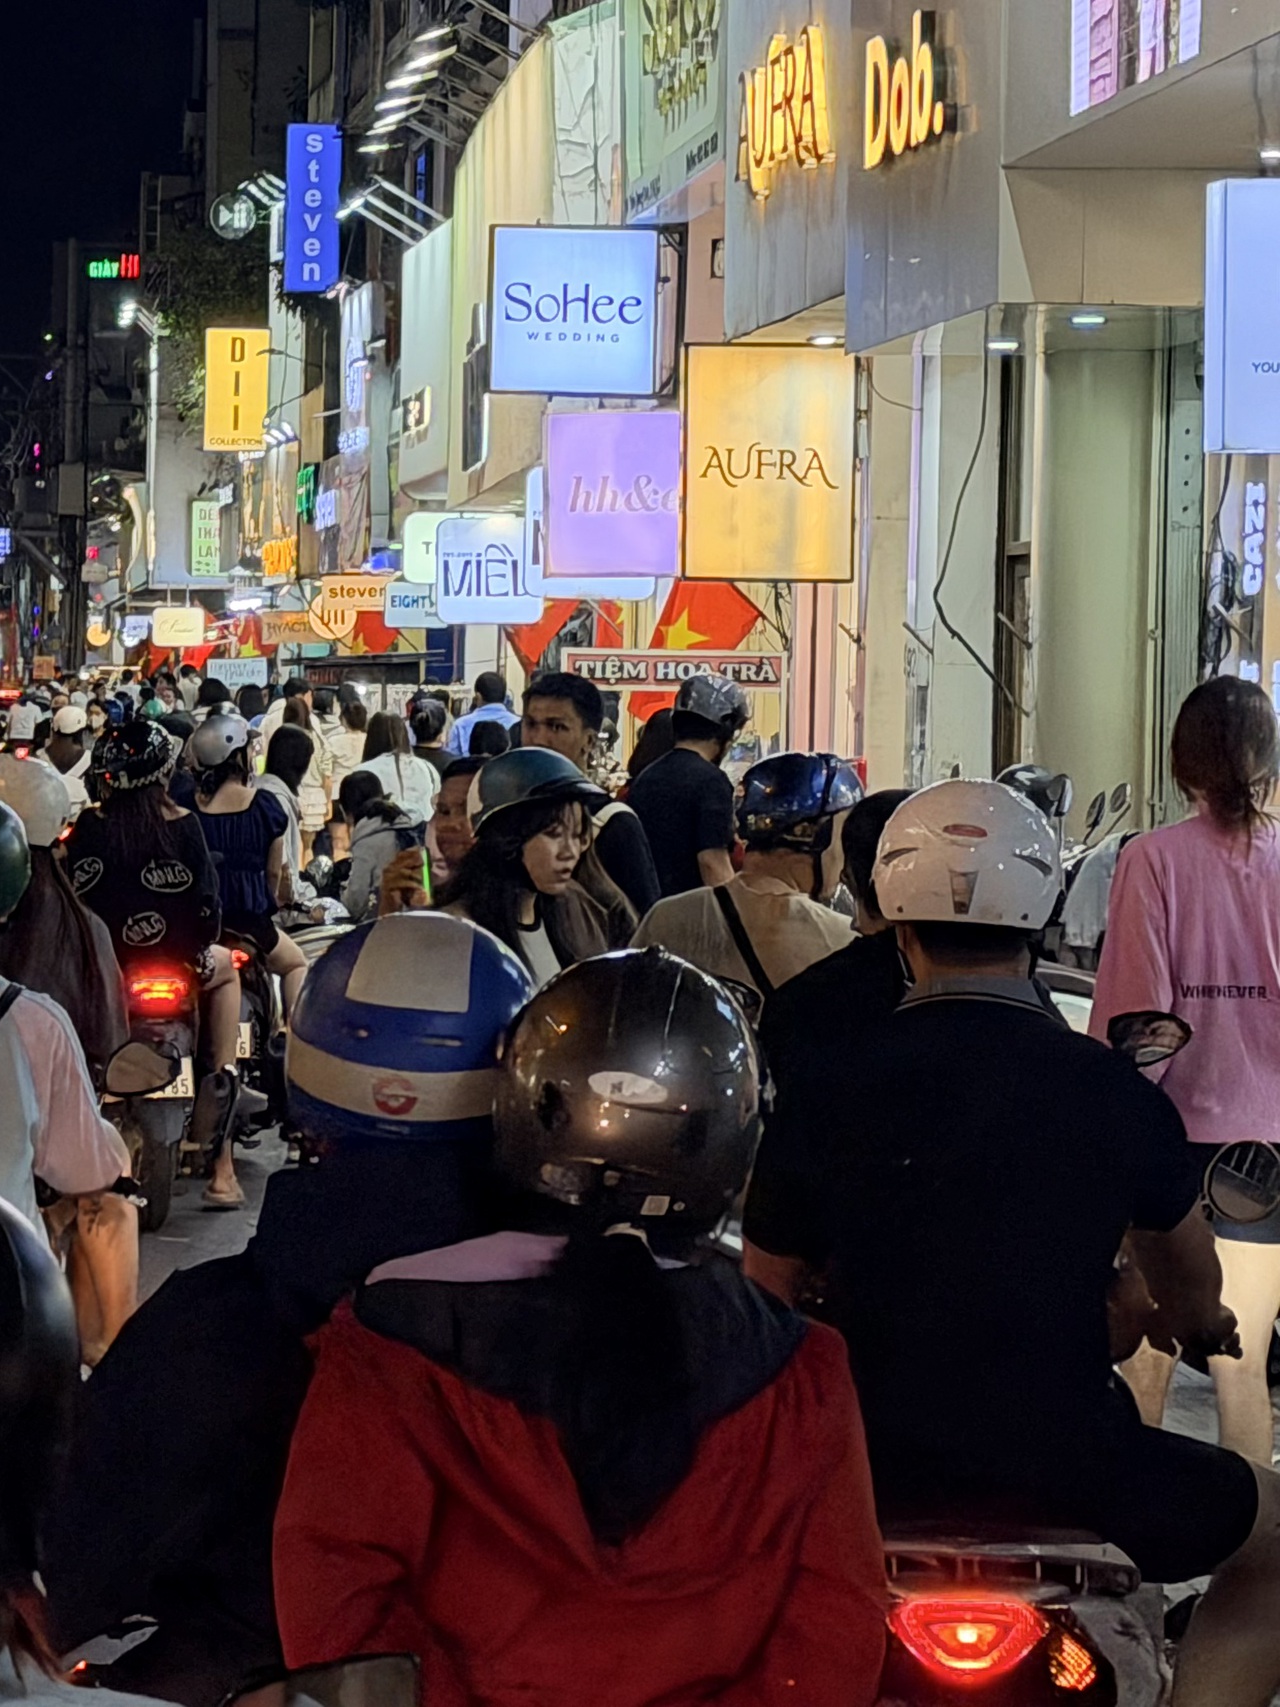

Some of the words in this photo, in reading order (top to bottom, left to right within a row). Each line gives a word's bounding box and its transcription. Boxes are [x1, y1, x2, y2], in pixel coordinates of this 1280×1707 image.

[864, 9, 945, 170] Dob.
[734, 23, 835, 200] AUFRA
[303, 133, 324, 282] steven
[504, 282, 644, 325] SoHee
[526, 331, 621, 343] WEDDING
[209, 437, 263, 446] COLLECTION
[698, 442, 840, 490] AUFRA
[391, 594, 434, 609] EIGHT
[575, 656, 649, 685] TIỆM
[657, 660, 707, 681] HOA
[724, 656, 778, 683] TRÀ
[1180, 983, 1267, 999] WHENEVER
